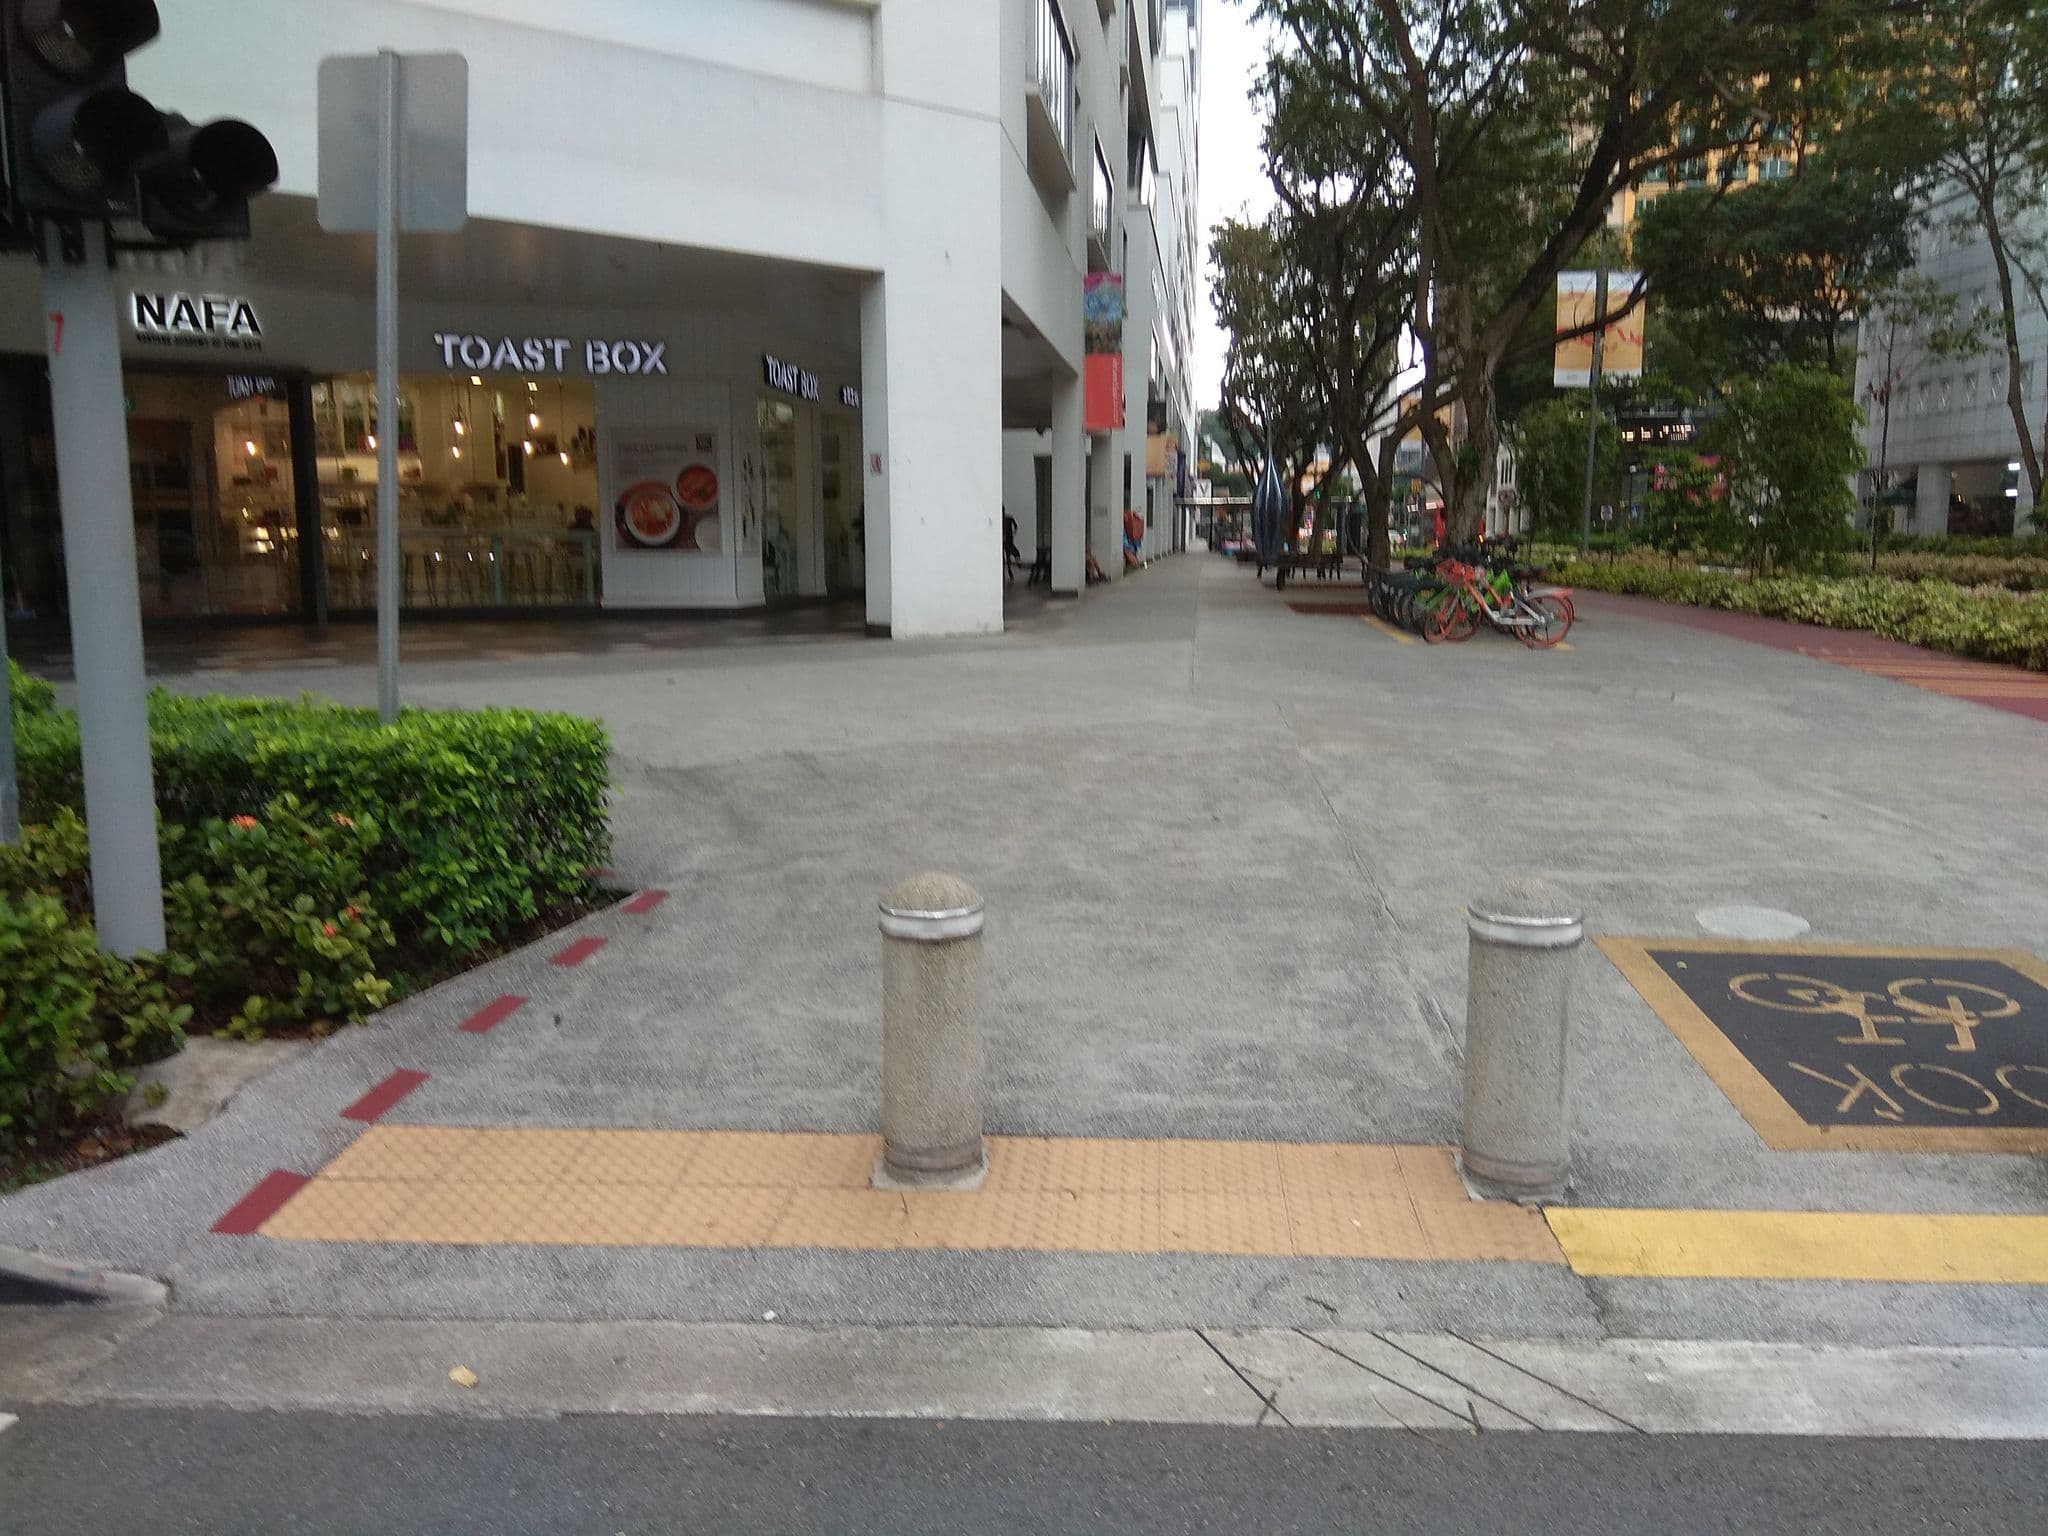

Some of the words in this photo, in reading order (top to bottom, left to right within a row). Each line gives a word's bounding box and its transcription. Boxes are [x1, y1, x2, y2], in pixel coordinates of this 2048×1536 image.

[131, 290, 264, 337] NAFA
[433, 332, 572, 373] TOAST
[585, 338, 668, 376] BOX
[765, 353, 799, 394] TOAST
[800, 369, 820, 402] BOX
